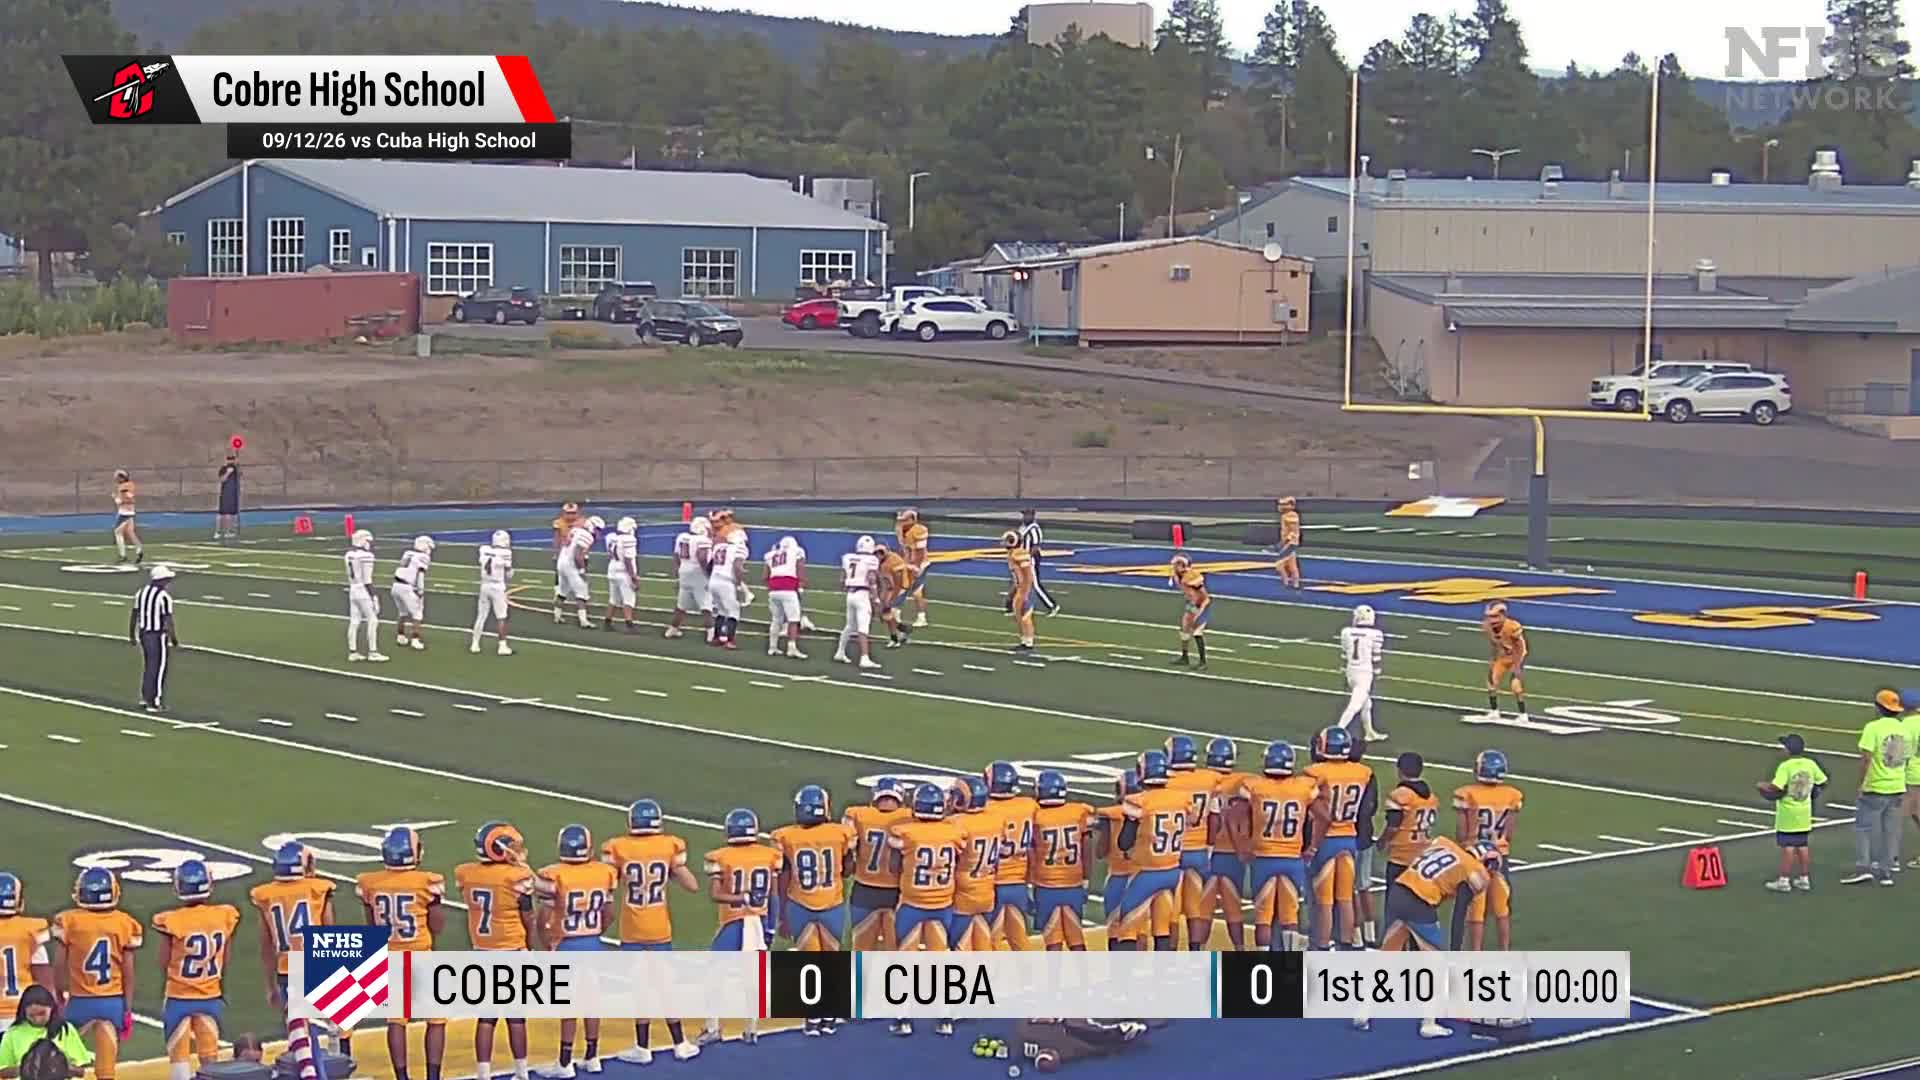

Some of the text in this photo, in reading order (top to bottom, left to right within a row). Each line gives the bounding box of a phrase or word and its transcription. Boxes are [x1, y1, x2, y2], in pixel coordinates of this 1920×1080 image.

[1351, 637, 1360, 661] 1
[1262, 799, 1300, 840] 76
[1329, 783, 1362, 822] 12
[1042, 825, 1079, 867] 75
[1151, 811, 1185, 854] 52
[1477, 807, 1513, 842] 24
[624, 862, 668, 905] 22
[795, 847, 834, 891] 81
[914, 846, 956, 888] 23
[1698, 853, 1722, 881] 20
[271, 900, 310, 951] 14
[374, 893, 417, 941] 35
[470, 889, 494, 936] 7
[84, 936, 112, 985] 4
[181, 931, 225, 979] 21
